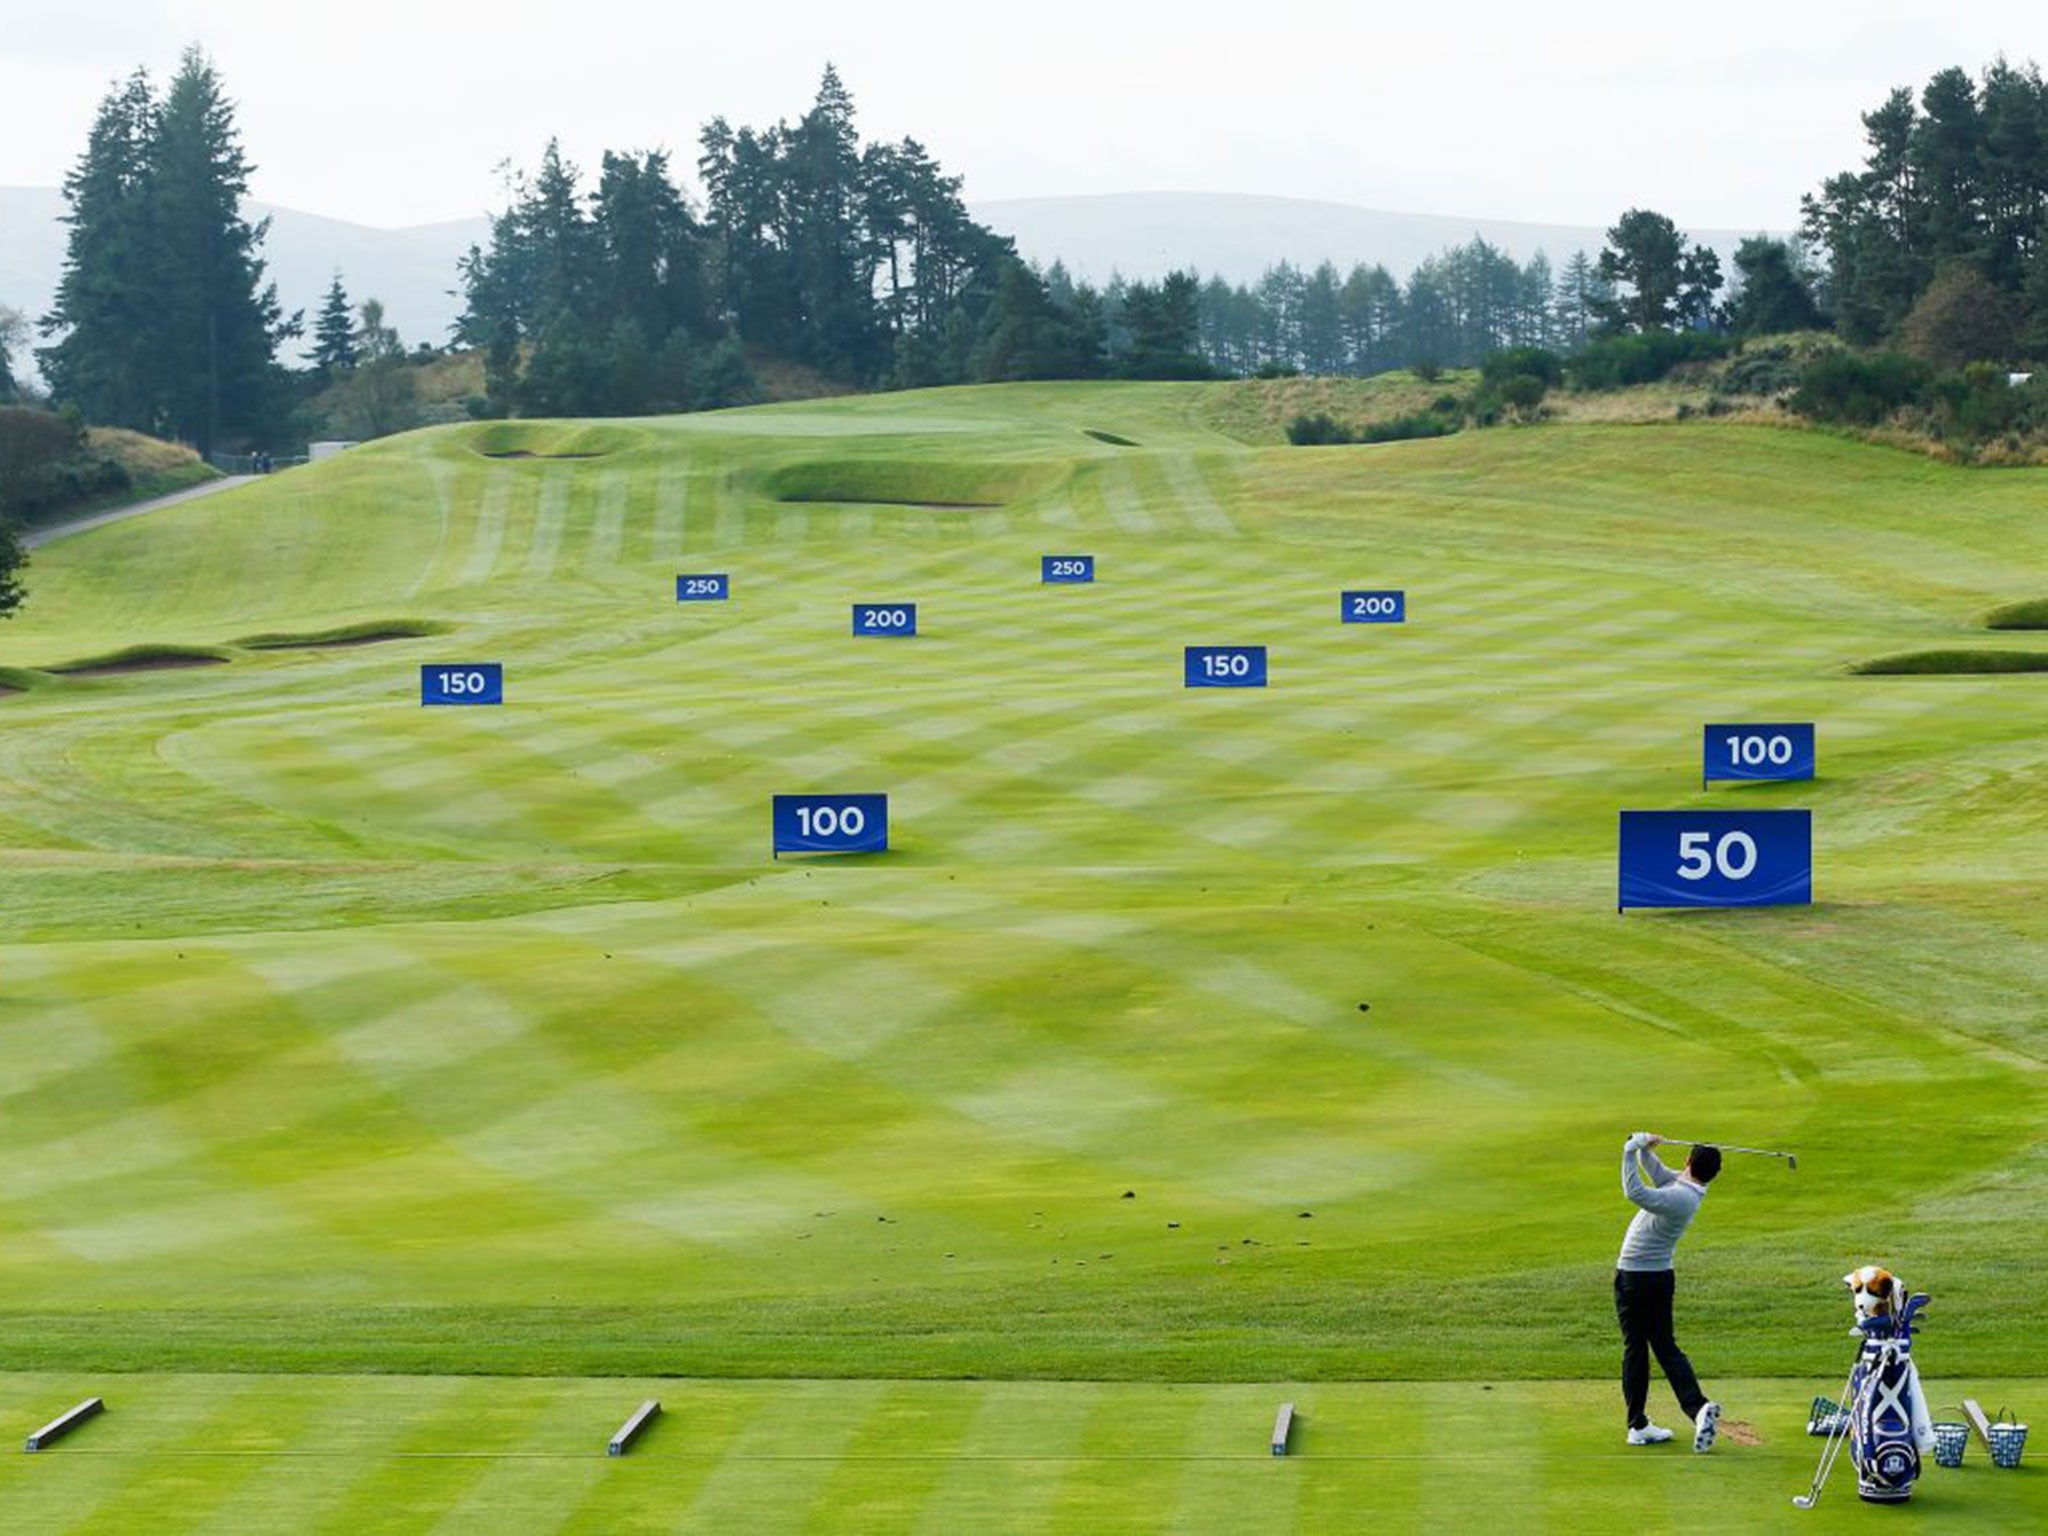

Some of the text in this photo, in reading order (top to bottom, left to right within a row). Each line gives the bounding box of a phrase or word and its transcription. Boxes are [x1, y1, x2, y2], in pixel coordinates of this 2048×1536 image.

[1052, 561, 1085, 575] 250
[686, 580, 719, 594] 250
[1354, 597, 1396, 614] 200
[864, 610, 906, 627] 200
[1203, 654, 1249, 676] 150
[439, 672, 485, 694] 150
[1726, 735, 1792, 764] 100
[796, 806, 865, 836] 100
[1676, 831, 1757, 881] 50
